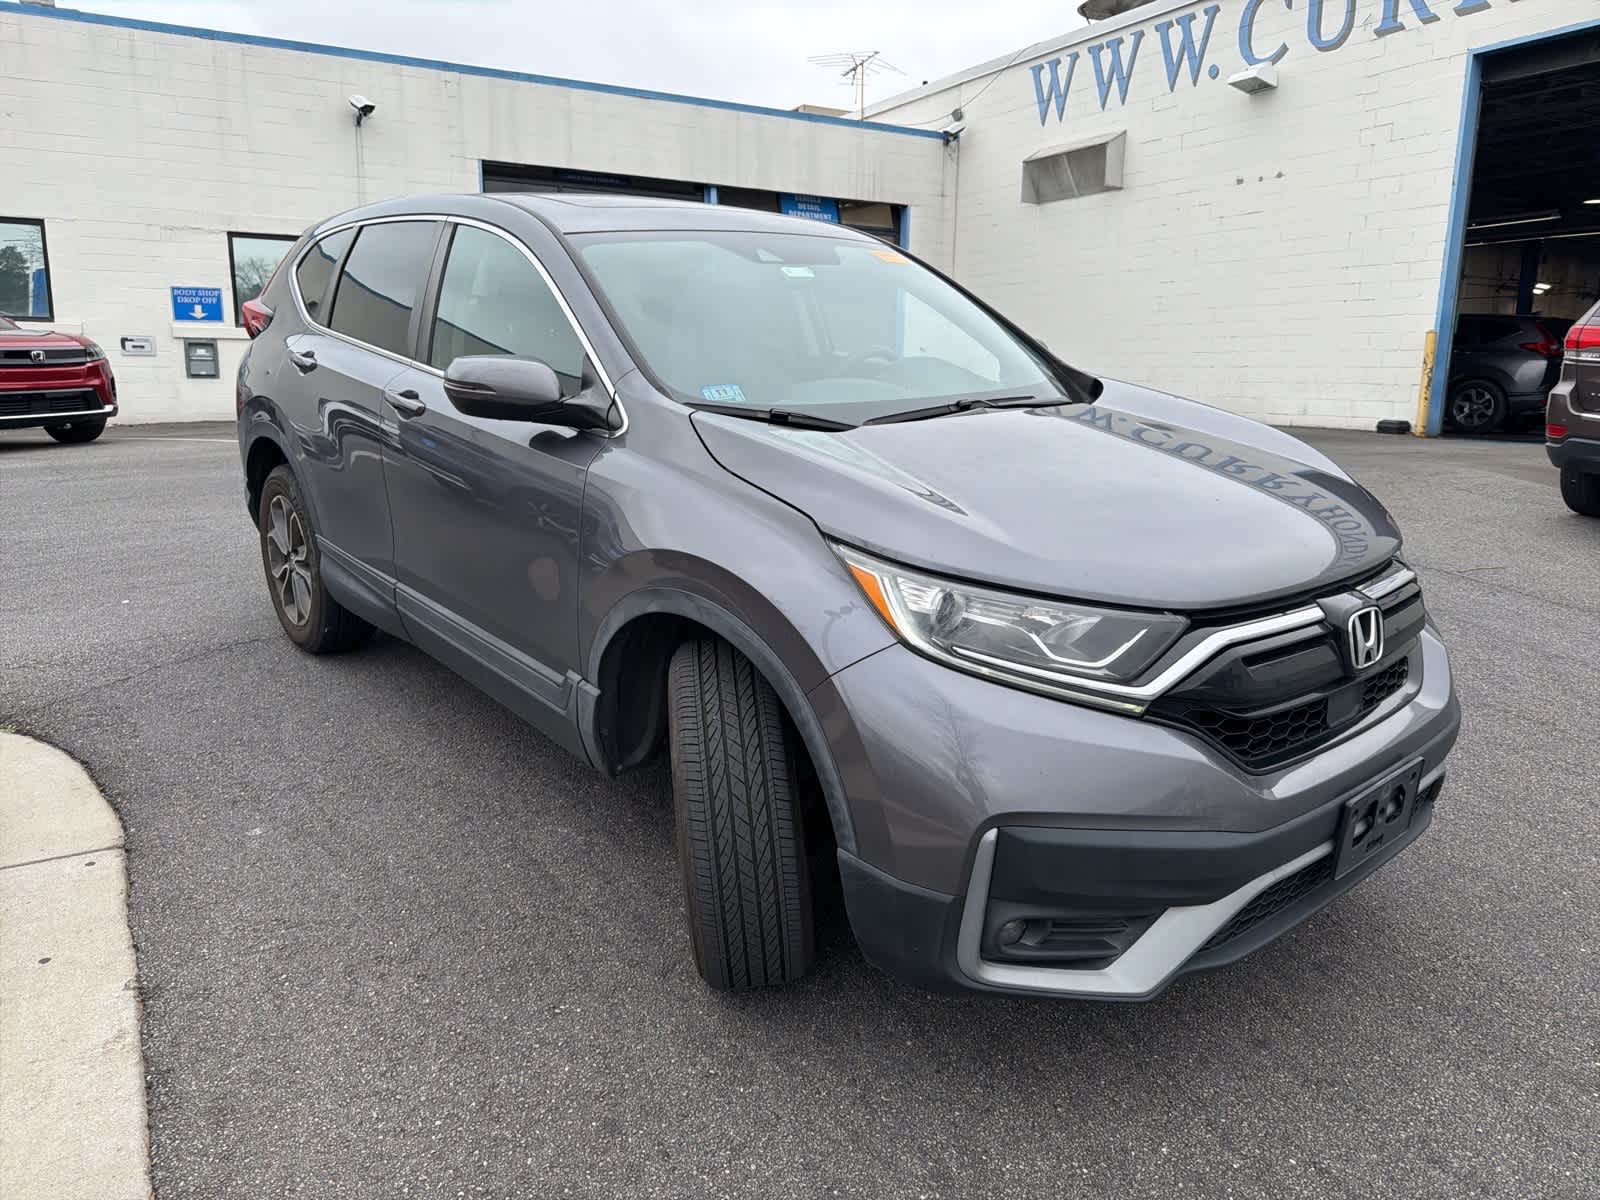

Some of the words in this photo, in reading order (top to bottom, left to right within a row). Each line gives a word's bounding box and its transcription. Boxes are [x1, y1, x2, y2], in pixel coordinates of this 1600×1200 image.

[1029, 0, 1493, 128] WWW.CU
[197, 289, 219, 297] SHOP
[177, 296, 201, 304] DROP
[201, 296, 218, 304] OFF
